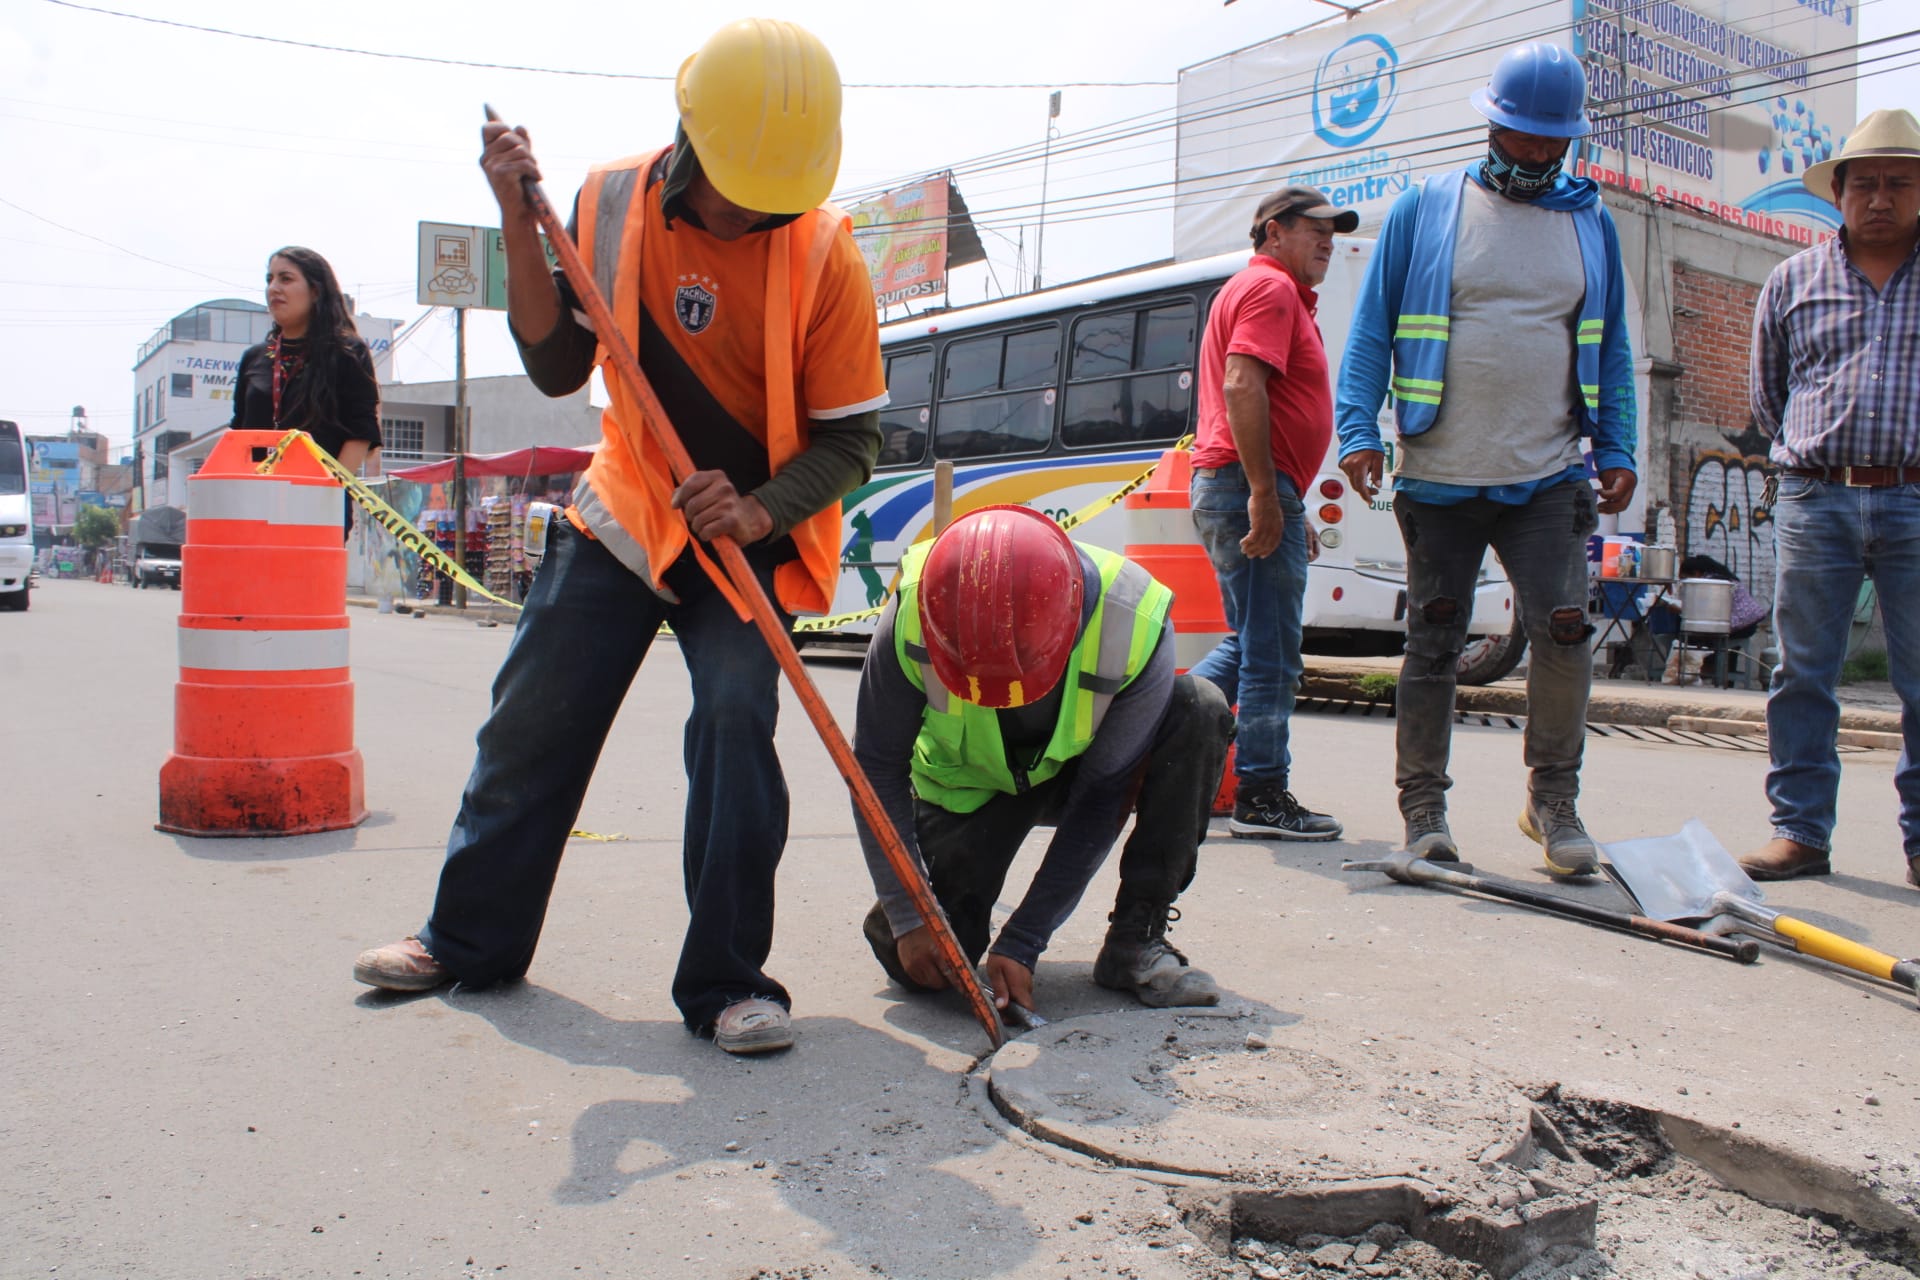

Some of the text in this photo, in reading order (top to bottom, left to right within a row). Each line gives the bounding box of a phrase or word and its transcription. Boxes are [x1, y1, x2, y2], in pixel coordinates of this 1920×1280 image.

[1588, 15, 1732, 101] RECAGAS TELEFÓNICAS
[1652, 1, 1726, 56] QUIRÚRGICO
[1728, 28, 1736, 60] Y
[1738, 33, 1752, 67] DE
[1754, 40, 1807, 88] CURACIÓN
[1659, 89, 1708, 137] TARJETA
[1287, 148, 1389, 187] Farmacia
[1631, 123, 1647, 159] DE
[1649, 128, 1713, 181] SERVICIOS
